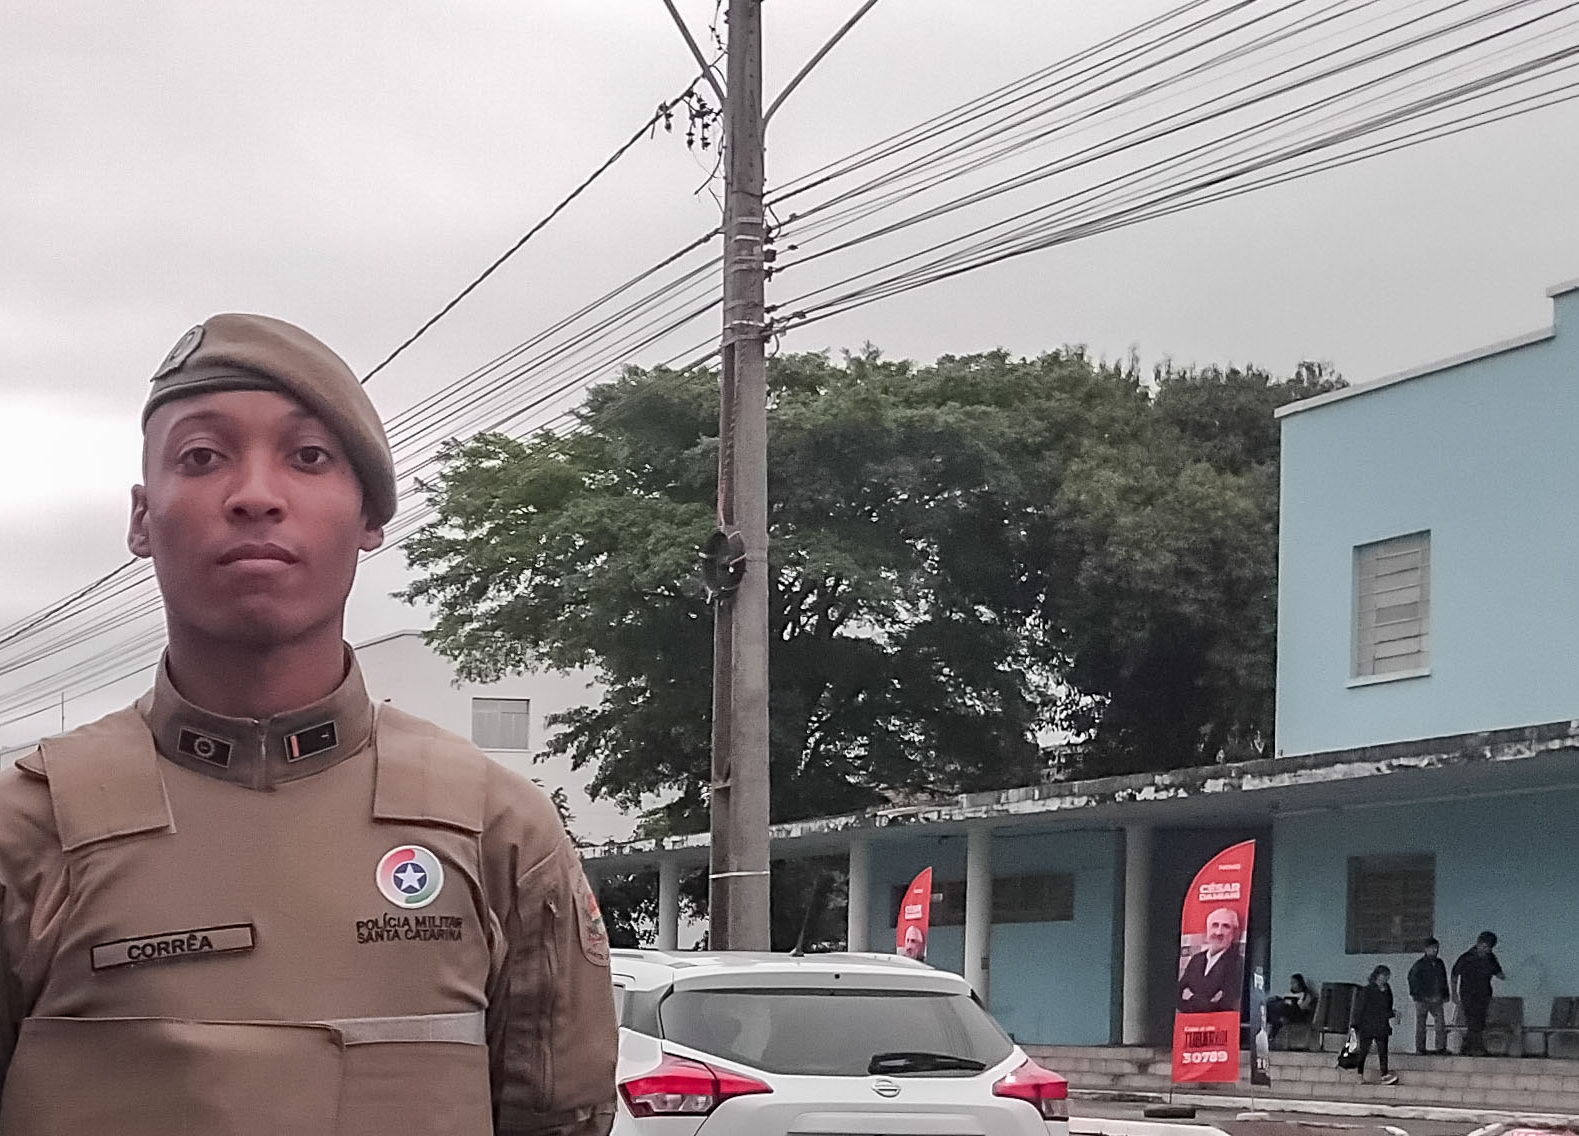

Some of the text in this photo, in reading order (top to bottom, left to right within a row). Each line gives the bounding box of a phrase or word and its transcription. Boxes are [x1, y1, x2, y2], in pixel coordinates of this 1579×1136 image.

[356, 912, 463, 932] POLÍCIA MILITAR
[357, 929, 463, 944] SANTA CATARINA
[127, 933, 213, 960] CORRÊA
[1182, 1051, 1228, 1064] 30789
